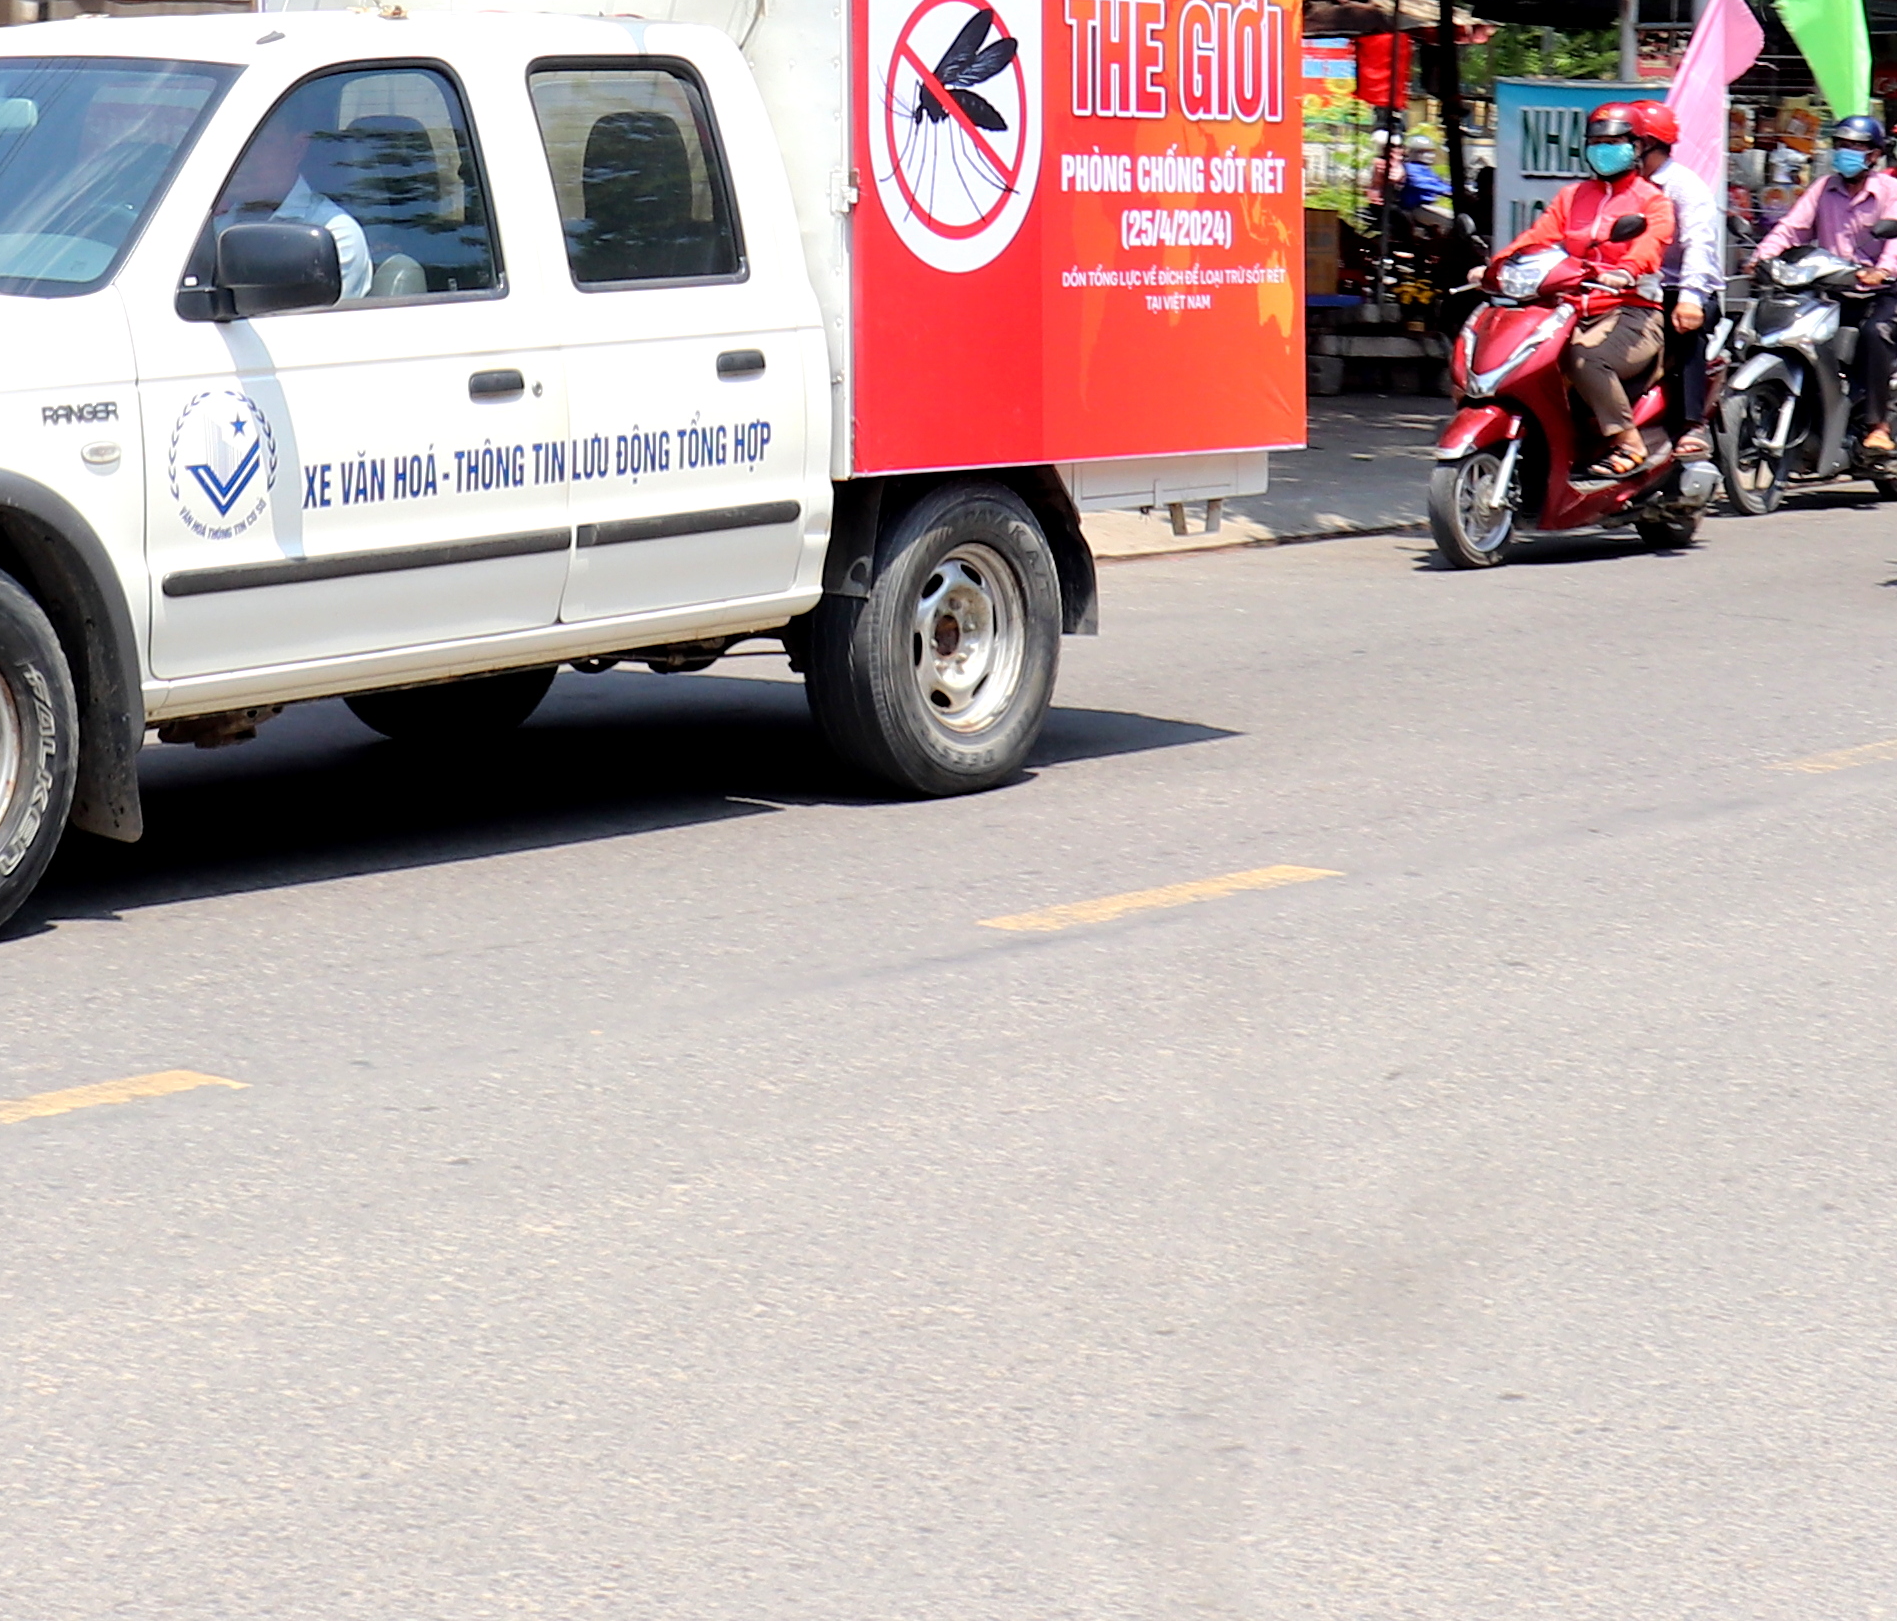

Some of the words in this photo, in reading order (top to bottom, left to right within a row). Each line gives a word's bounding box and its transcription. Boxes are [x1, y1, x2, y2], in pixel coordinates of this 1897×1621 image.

[1060, 144, 1132, 193] PHÒNG
[1136, 142, 1205, 194] CHỐNG
[1209, 144, 1247, 194] SỐT
[1250, 150, 1286, 194] RÉT
[1121, 209, 1233, 251] (25/4/2024)
[1187, 294, 1212, 310] NAM
[41, 401, 120, 427] RANGER
[302, 462, 332, 510] XE
[340, 449, 386, 506] VĂN
[393, 442, 438, 500] HOÁ
[454, 437, 525, 494] THÔNG
[532, 439, 566, 486] TIN
[571, 431, 610, 481] LƯU
[615, 423, 671, 486] ĐỘNG
[676, 409, 728, 470] TỔNG
[733, 418, 772, 473] HỢP
[0, 663, 58, 877] FALKEN
